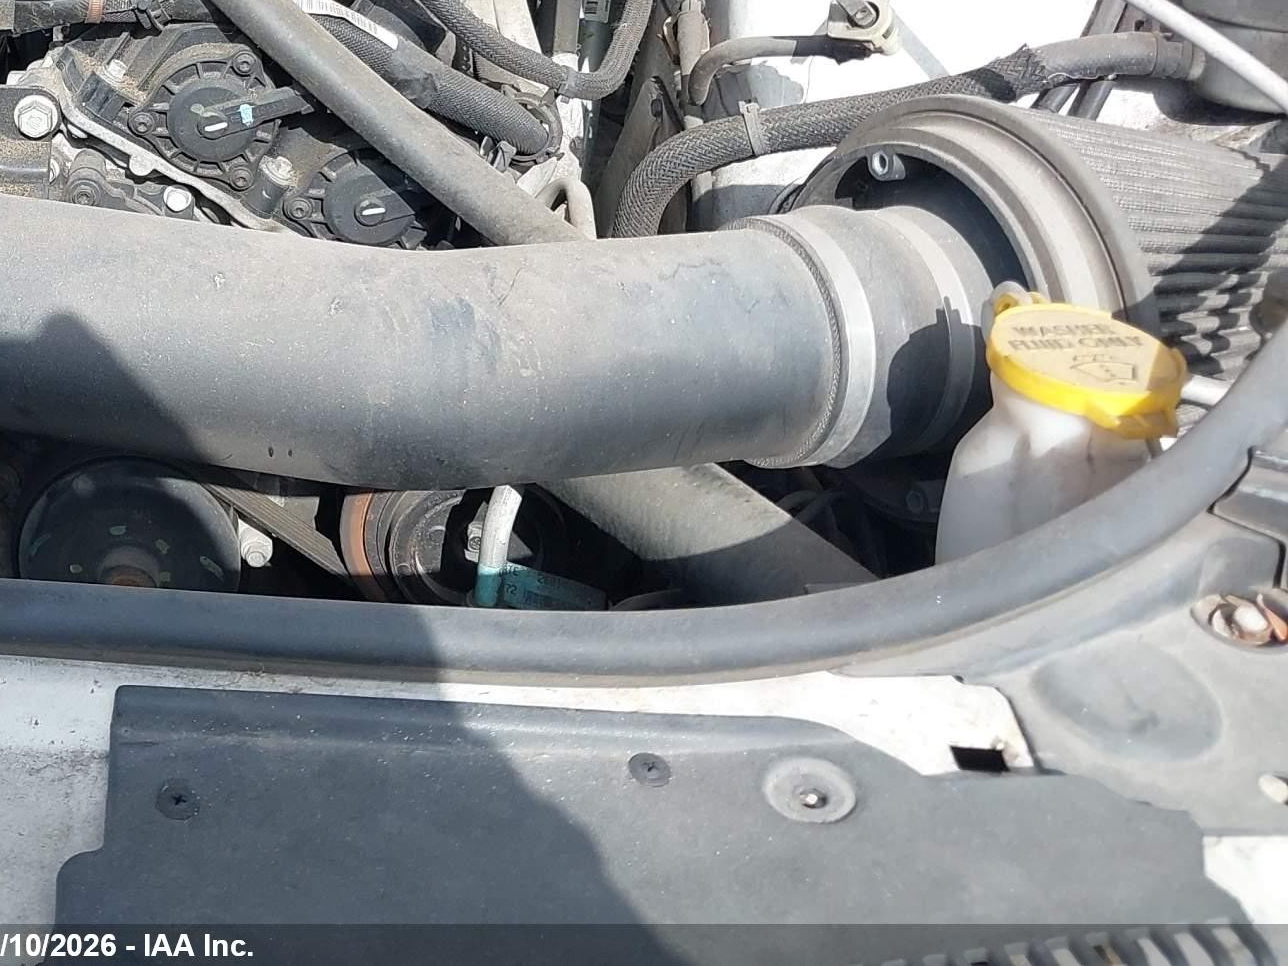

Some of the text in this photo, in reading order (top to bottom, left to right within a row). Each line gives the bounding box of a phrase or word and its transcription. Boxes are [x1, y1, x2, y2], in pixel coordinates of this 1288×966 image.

[1011, 323, 1117, 337] WASHER
[1008, 336, 1144, 351] FLUID ONLY
